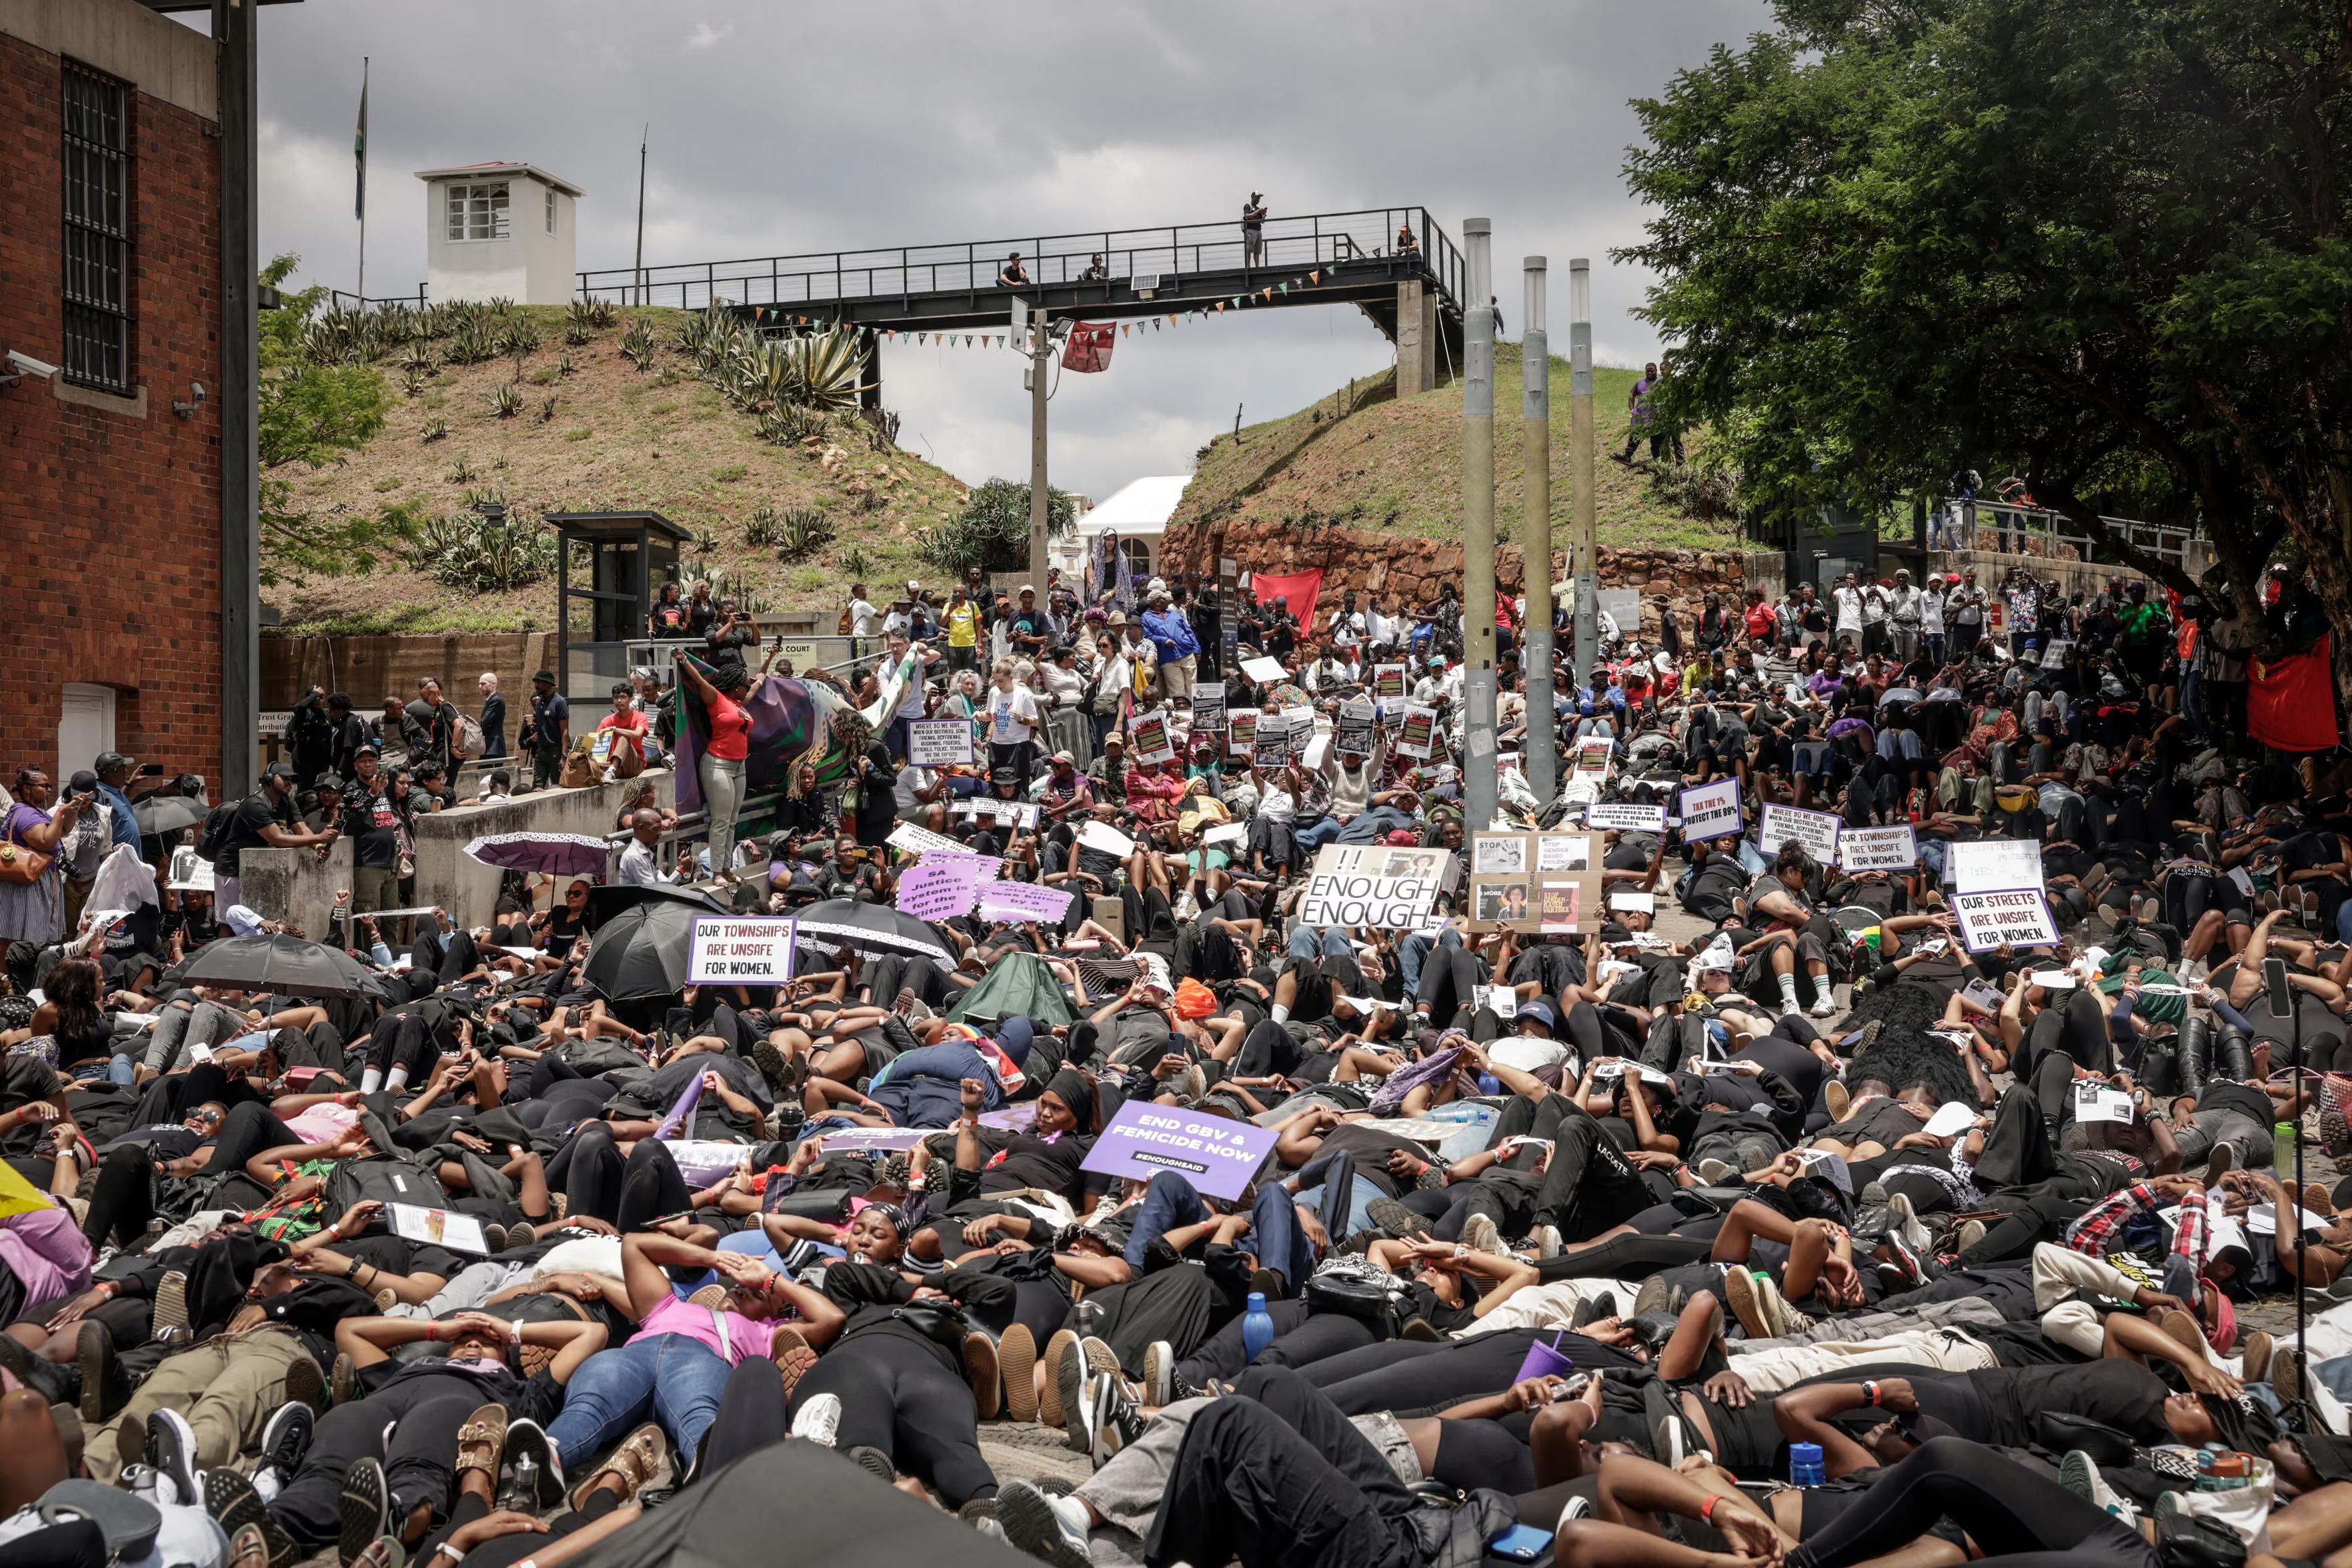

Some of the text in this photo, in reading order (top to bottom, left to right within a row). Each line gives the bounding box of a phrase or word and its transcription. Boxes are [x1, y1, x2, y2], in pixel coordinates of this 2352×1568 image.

[1692, 796, 1726, 811] TAX THE 1%
[1684, 805, 1737, 826] PROTECT THE 99%
[1773, 807, 1793, 817] WHERE
[907, 822, 926, 833] HOW
[927, 831, 949, 843] MANY
[1840, 831, 1910, 842] OUR TOWNSHIPS
[1765, 833, 1788, 841] OFFICIALS
[1810, 841, 1831, 849] TEACHERS
[1850, 843, 1901, 853] ARE UNSAFE
[1853, 855, 1906, 865] FOR WOMEN.
[911, 878, 962, 891] Justice
[1310, 875, 1438, 900] ENOUGH
[904, 887, 952, 903] system
[912, 895, 956, 909] for the
[1024, 894, 1064, 903] killed
[1961, 893, 2036, 909] OUR STREETS
[1302, 900, 1430, 927] ENOUGH
[1971, 911, 2037, 927] ARE UNSAFE
[698, 925, 789, 937] OUR TOWNSHIPS
[1977, 927, 2047, 945] FOR WOMEN.
[707, 944, 774, 956] ARE UNSAFE
[706, 962, 774, 975] FOR WOMEN.
[1138, 1115, 1246, 1145] END GBV &
[1112, 1125, 1257, 1163] FEMICIDE NOW
[1135, 1153, 1204, 1172] #ENOUGHSAID
[1597, 1143, 1628, 1176] LACOSTE
[2237, 1394, 2255, 1416] ACK
